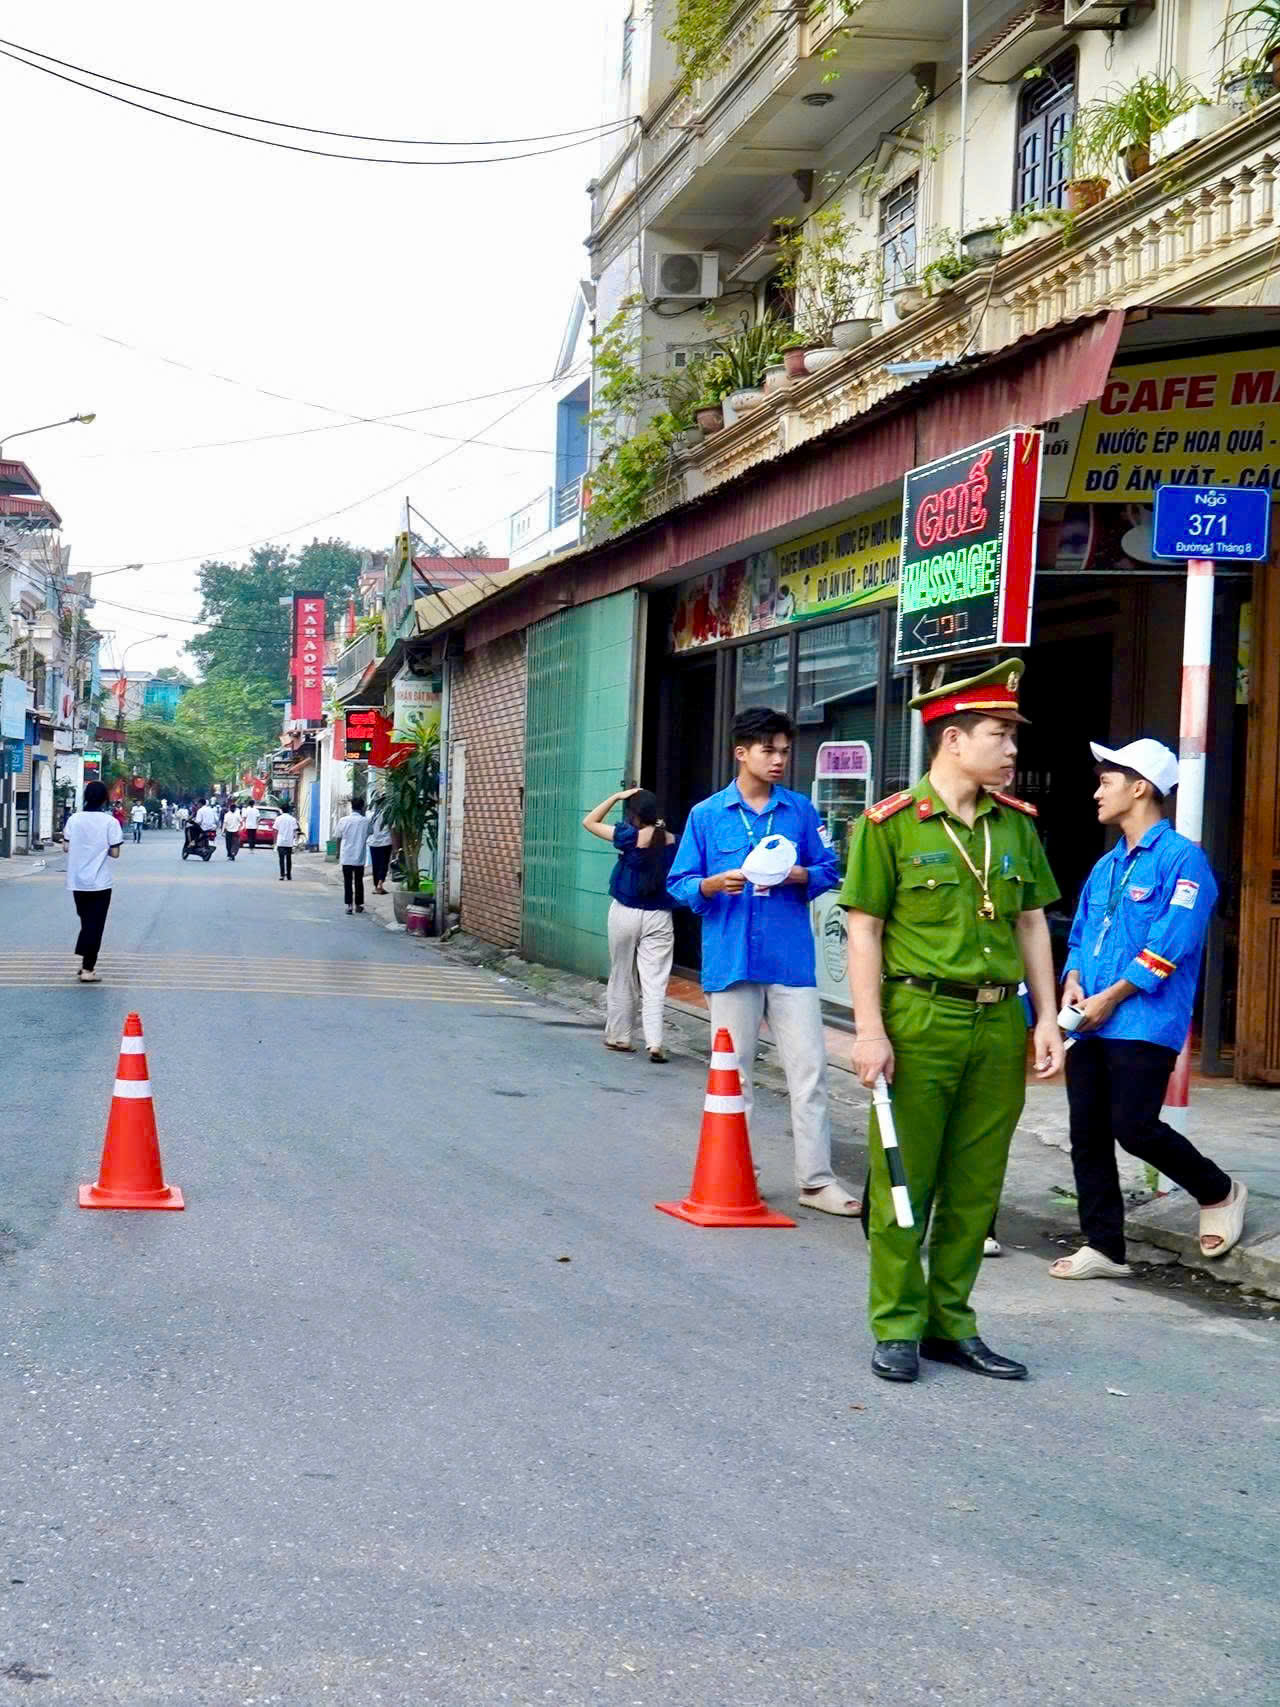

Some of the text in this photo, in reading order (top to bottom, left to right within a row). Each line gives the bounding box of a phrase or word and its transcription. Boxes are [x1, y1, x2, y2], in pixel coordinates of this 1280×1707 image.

[1100, 370, 1280, 415] CAFE M
[1096, 424, 1148, 454] NƯỚC
[1152, 426, 1178, 453] ÉP
[1183, 430, 1220, 453] HOA
[1227, 421, 1265, 454] QUẢ
[1085, 462, 1121, 491] ĐỒ
[1125, 465, 1161, 490] ĂN
[916, 450, 992, 548] GHẾ
[1195, 493, 1227, 507] Ngõ
[1188, 514, 1228, 536] 371
[1176, 541, 1208, 554] Đường
[1216, 542, 1245, 554] Tháng
[1245, 543, 1252, 552] 8
[903, 540, 998, 614] MASSAGE
[303, 602, 318, 688] KARAOKE
